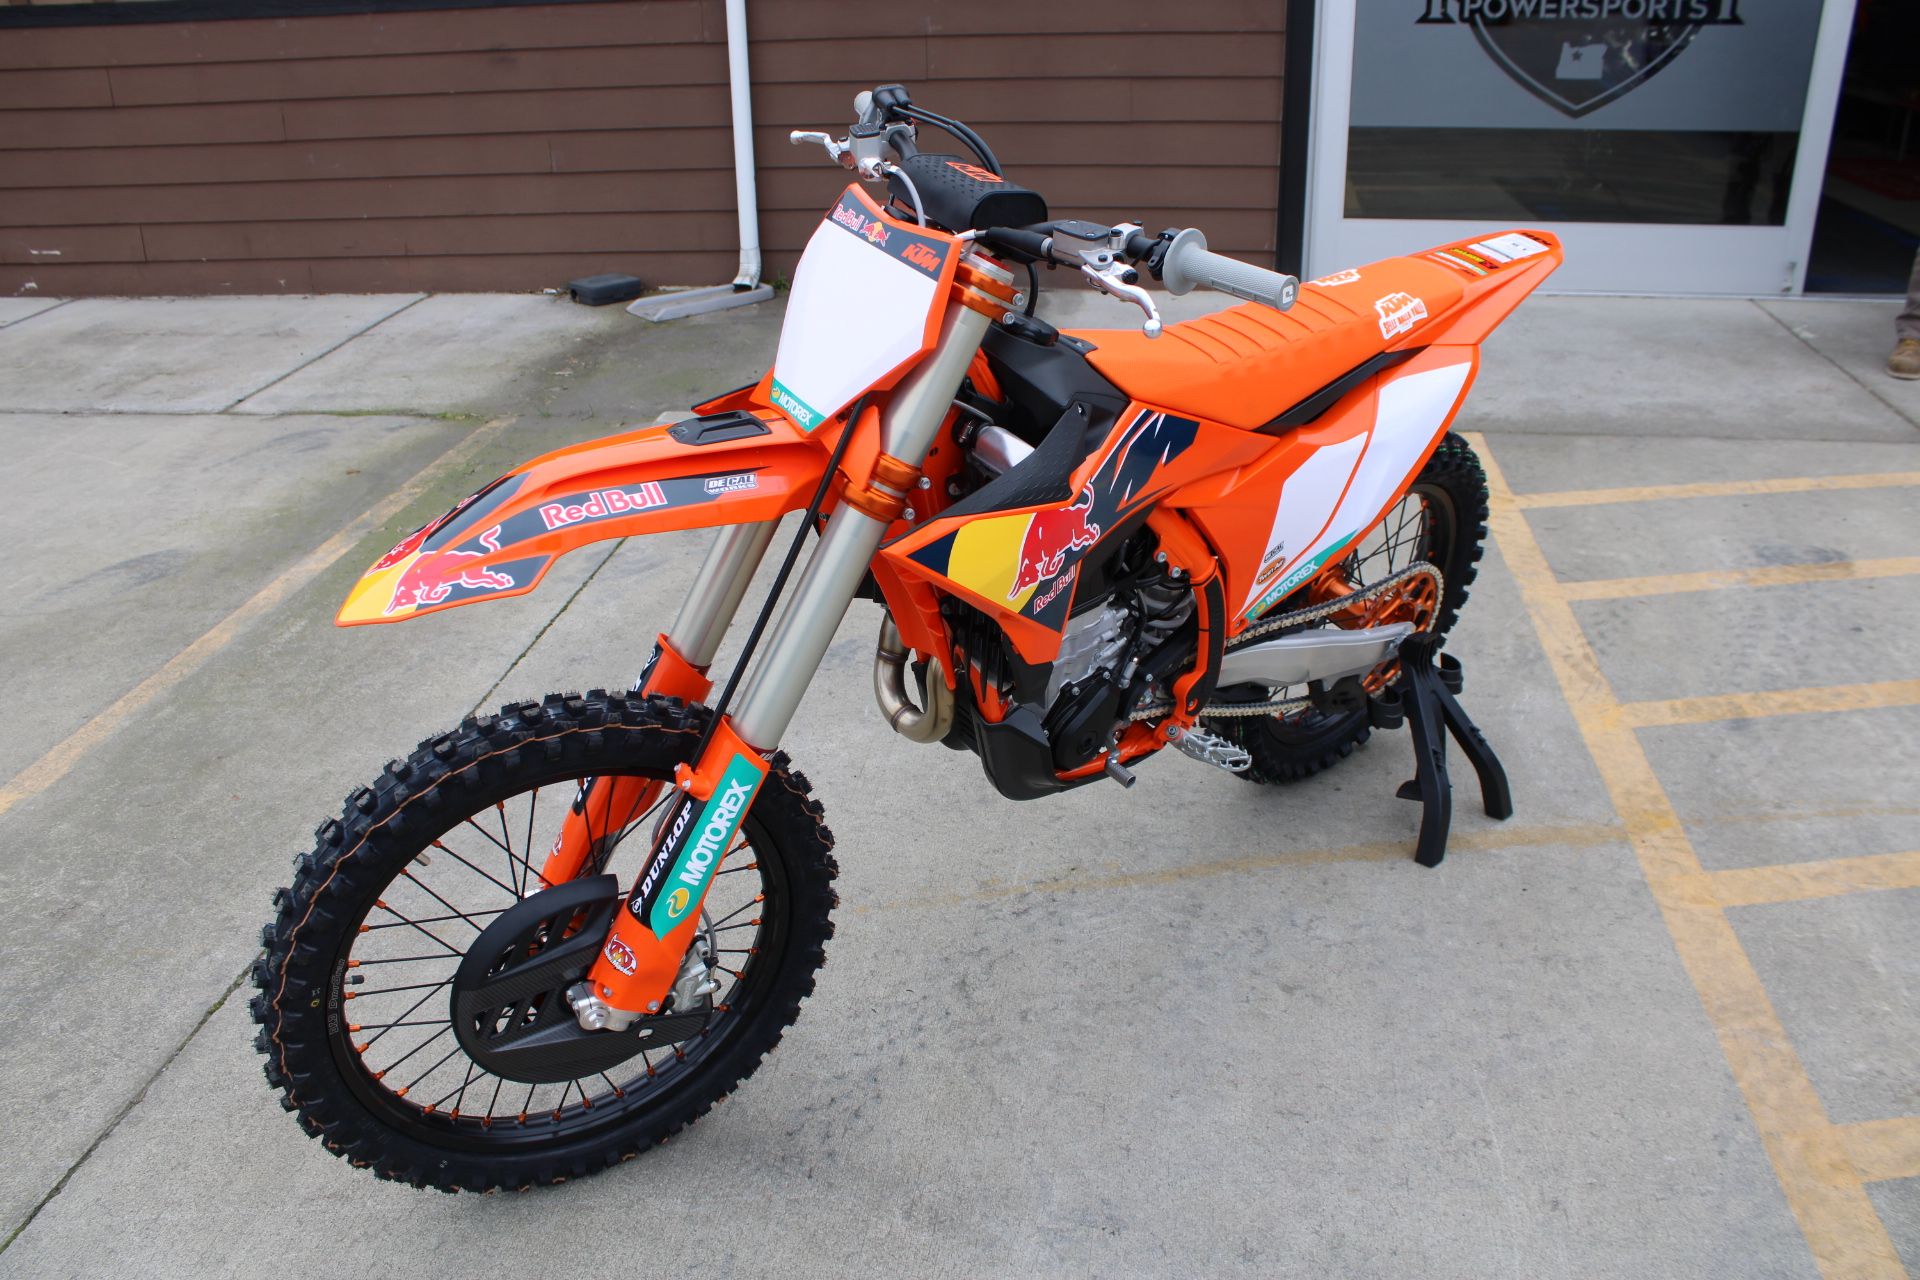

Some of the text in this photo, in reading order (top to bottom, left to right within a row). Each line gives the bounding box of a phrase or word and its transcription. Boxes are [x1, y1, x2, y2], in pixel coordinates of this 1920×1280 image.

[1463, 0, 1708, 18] POWERSPORTS
[901, 242, 941, 272] KTM
[778, 391, 813, 426] MOTOREX
[708, 474, 755, 488] DECAL
[540, 481, 667, 530] Red Bull
[1034, 563, 1076, 615] Red Bull
[1266, 560, 1320, 605] MOTOREX
[641, 801, 692, 899] DUNLOP
[679, 778, 753, 887] MOTOREX
